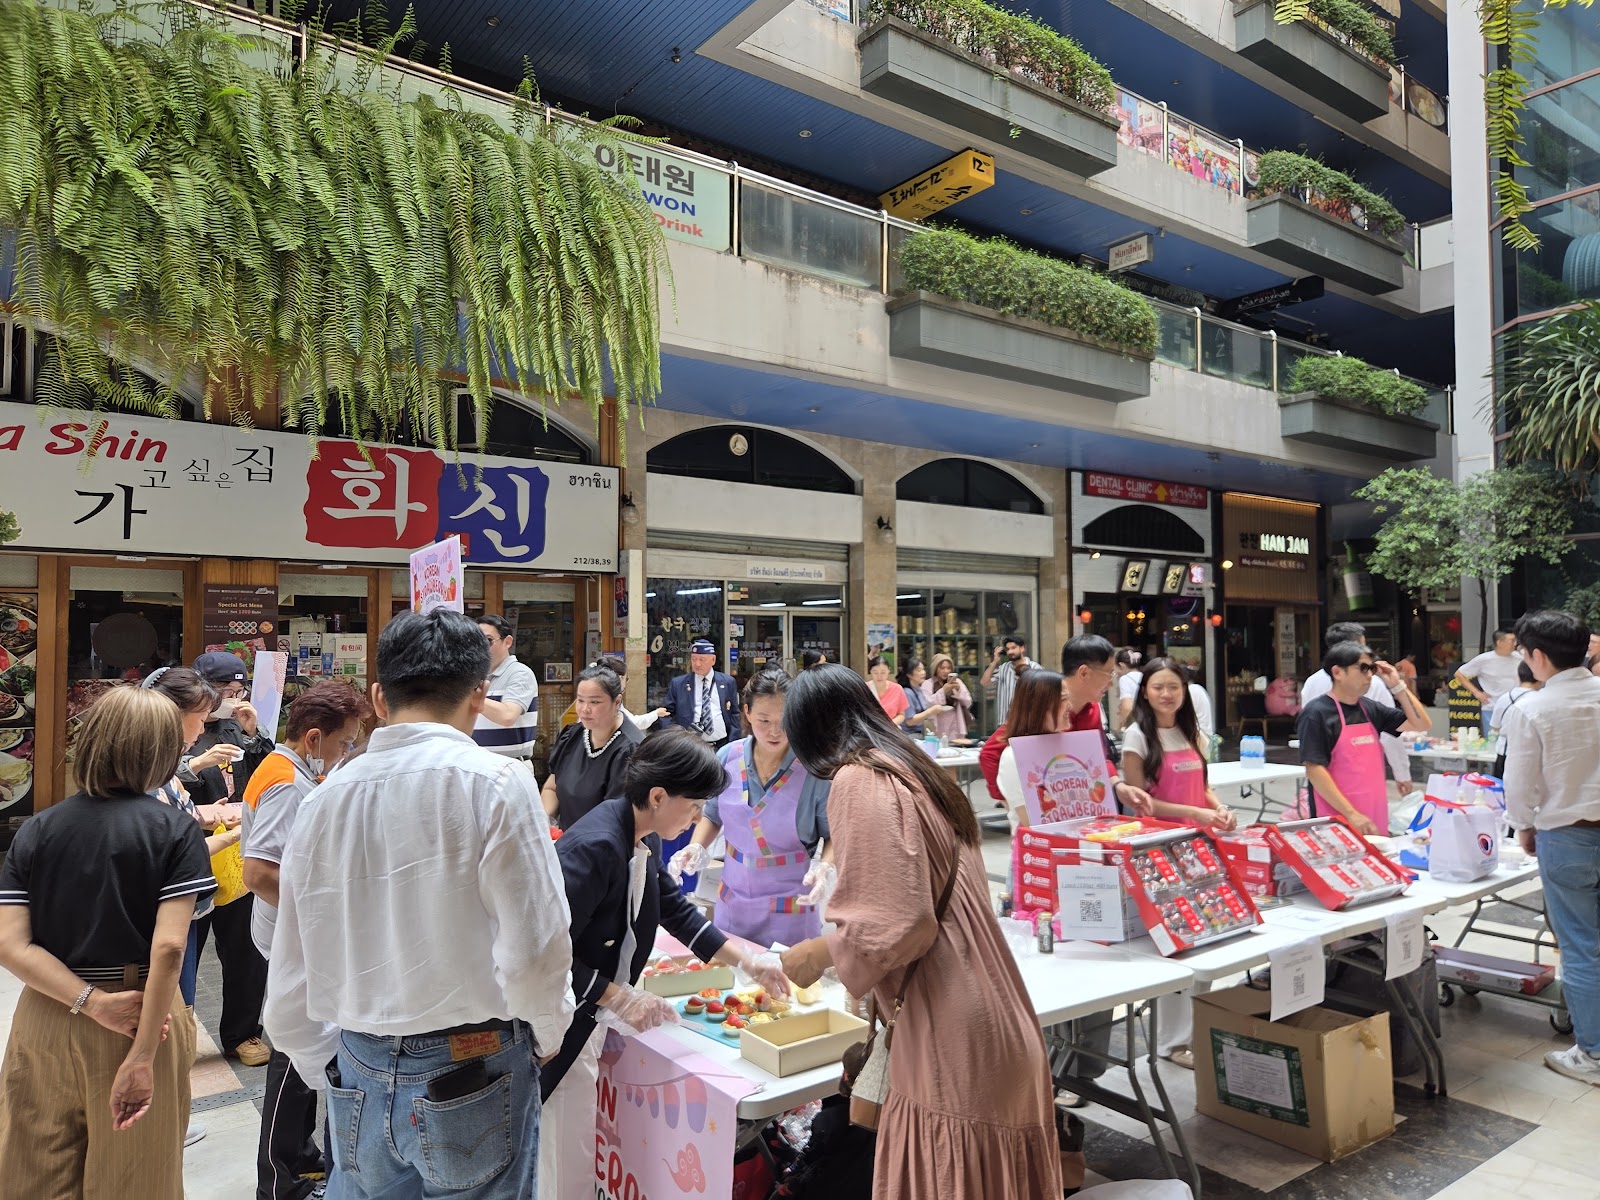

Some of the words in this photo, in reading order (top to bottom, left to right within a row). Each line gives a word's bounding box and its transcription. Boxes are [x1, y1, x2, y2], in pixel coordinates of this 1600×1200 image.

[595, 144, 695, 197] 이태원
[45, 420, 168, 463] Shin
[231, 445, 275, 483] 집
[569, 473, 612, 489] ฮวาซิน
[1089, 474, 1124, 490] DENTAL
[1125, 480, 1153, 493] CLINIC
[1097, 488, 1121, 496] SECOND
[1128, 491, 1146, 499] FLOOR
[1260, 533, 1286, 553] HAN
[1286, 535, 1309, 555] JAN
[573, 557, 612, 566] 212/38,39
[660, 616, 686, 633] 한국
[340, 644, 363, 652] 有包间
[667, 639, 692, 653] 빙그
[1050, 777, 1089, 793] KOREAN
